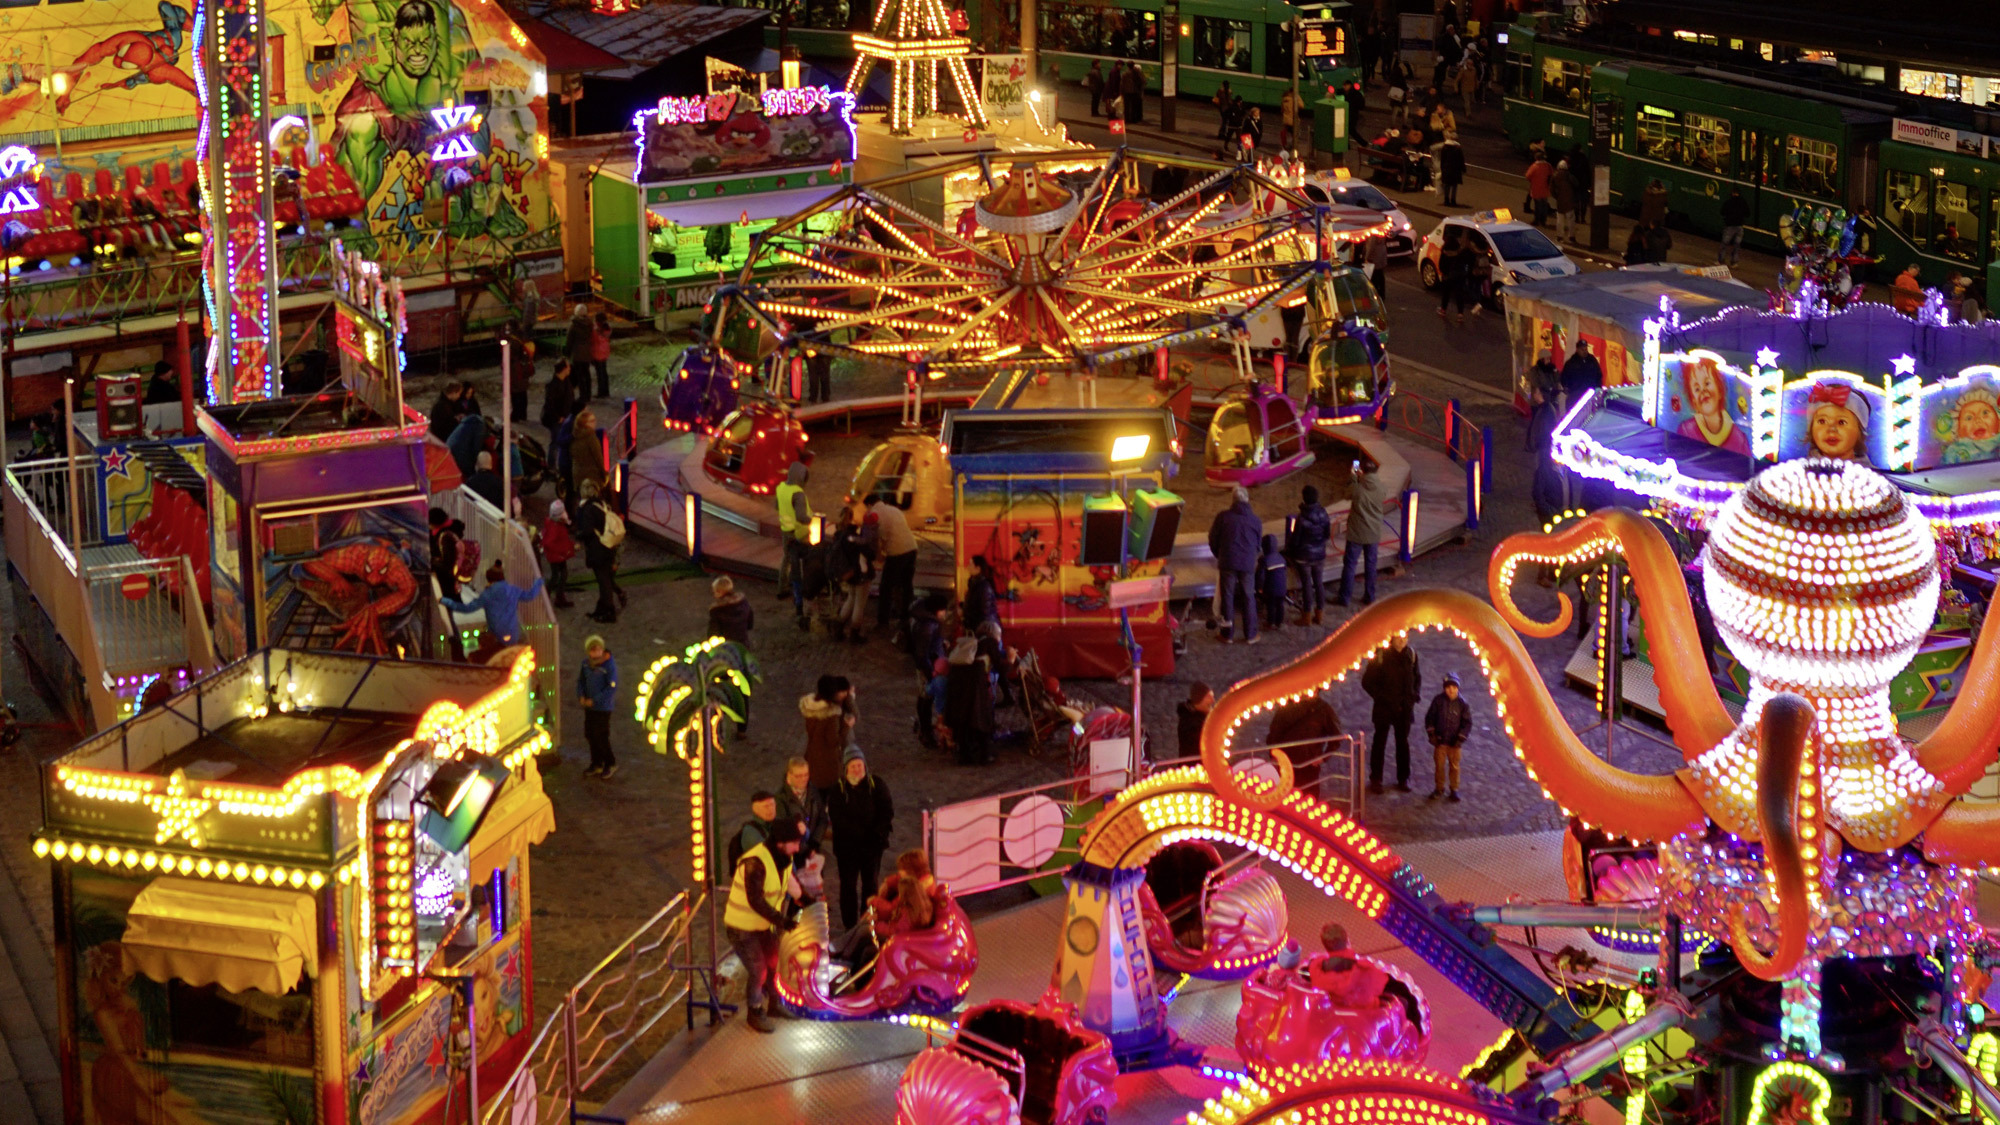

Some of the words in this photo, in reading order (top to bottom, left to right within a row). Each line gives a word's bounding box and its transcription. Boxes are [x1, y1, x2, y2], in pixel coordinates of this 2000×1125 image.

[657, 93, 736, 125] ANGRY
[761, 84, 830, 117] BIRDS
[1897, 120, 1951, 141] Immooffice
